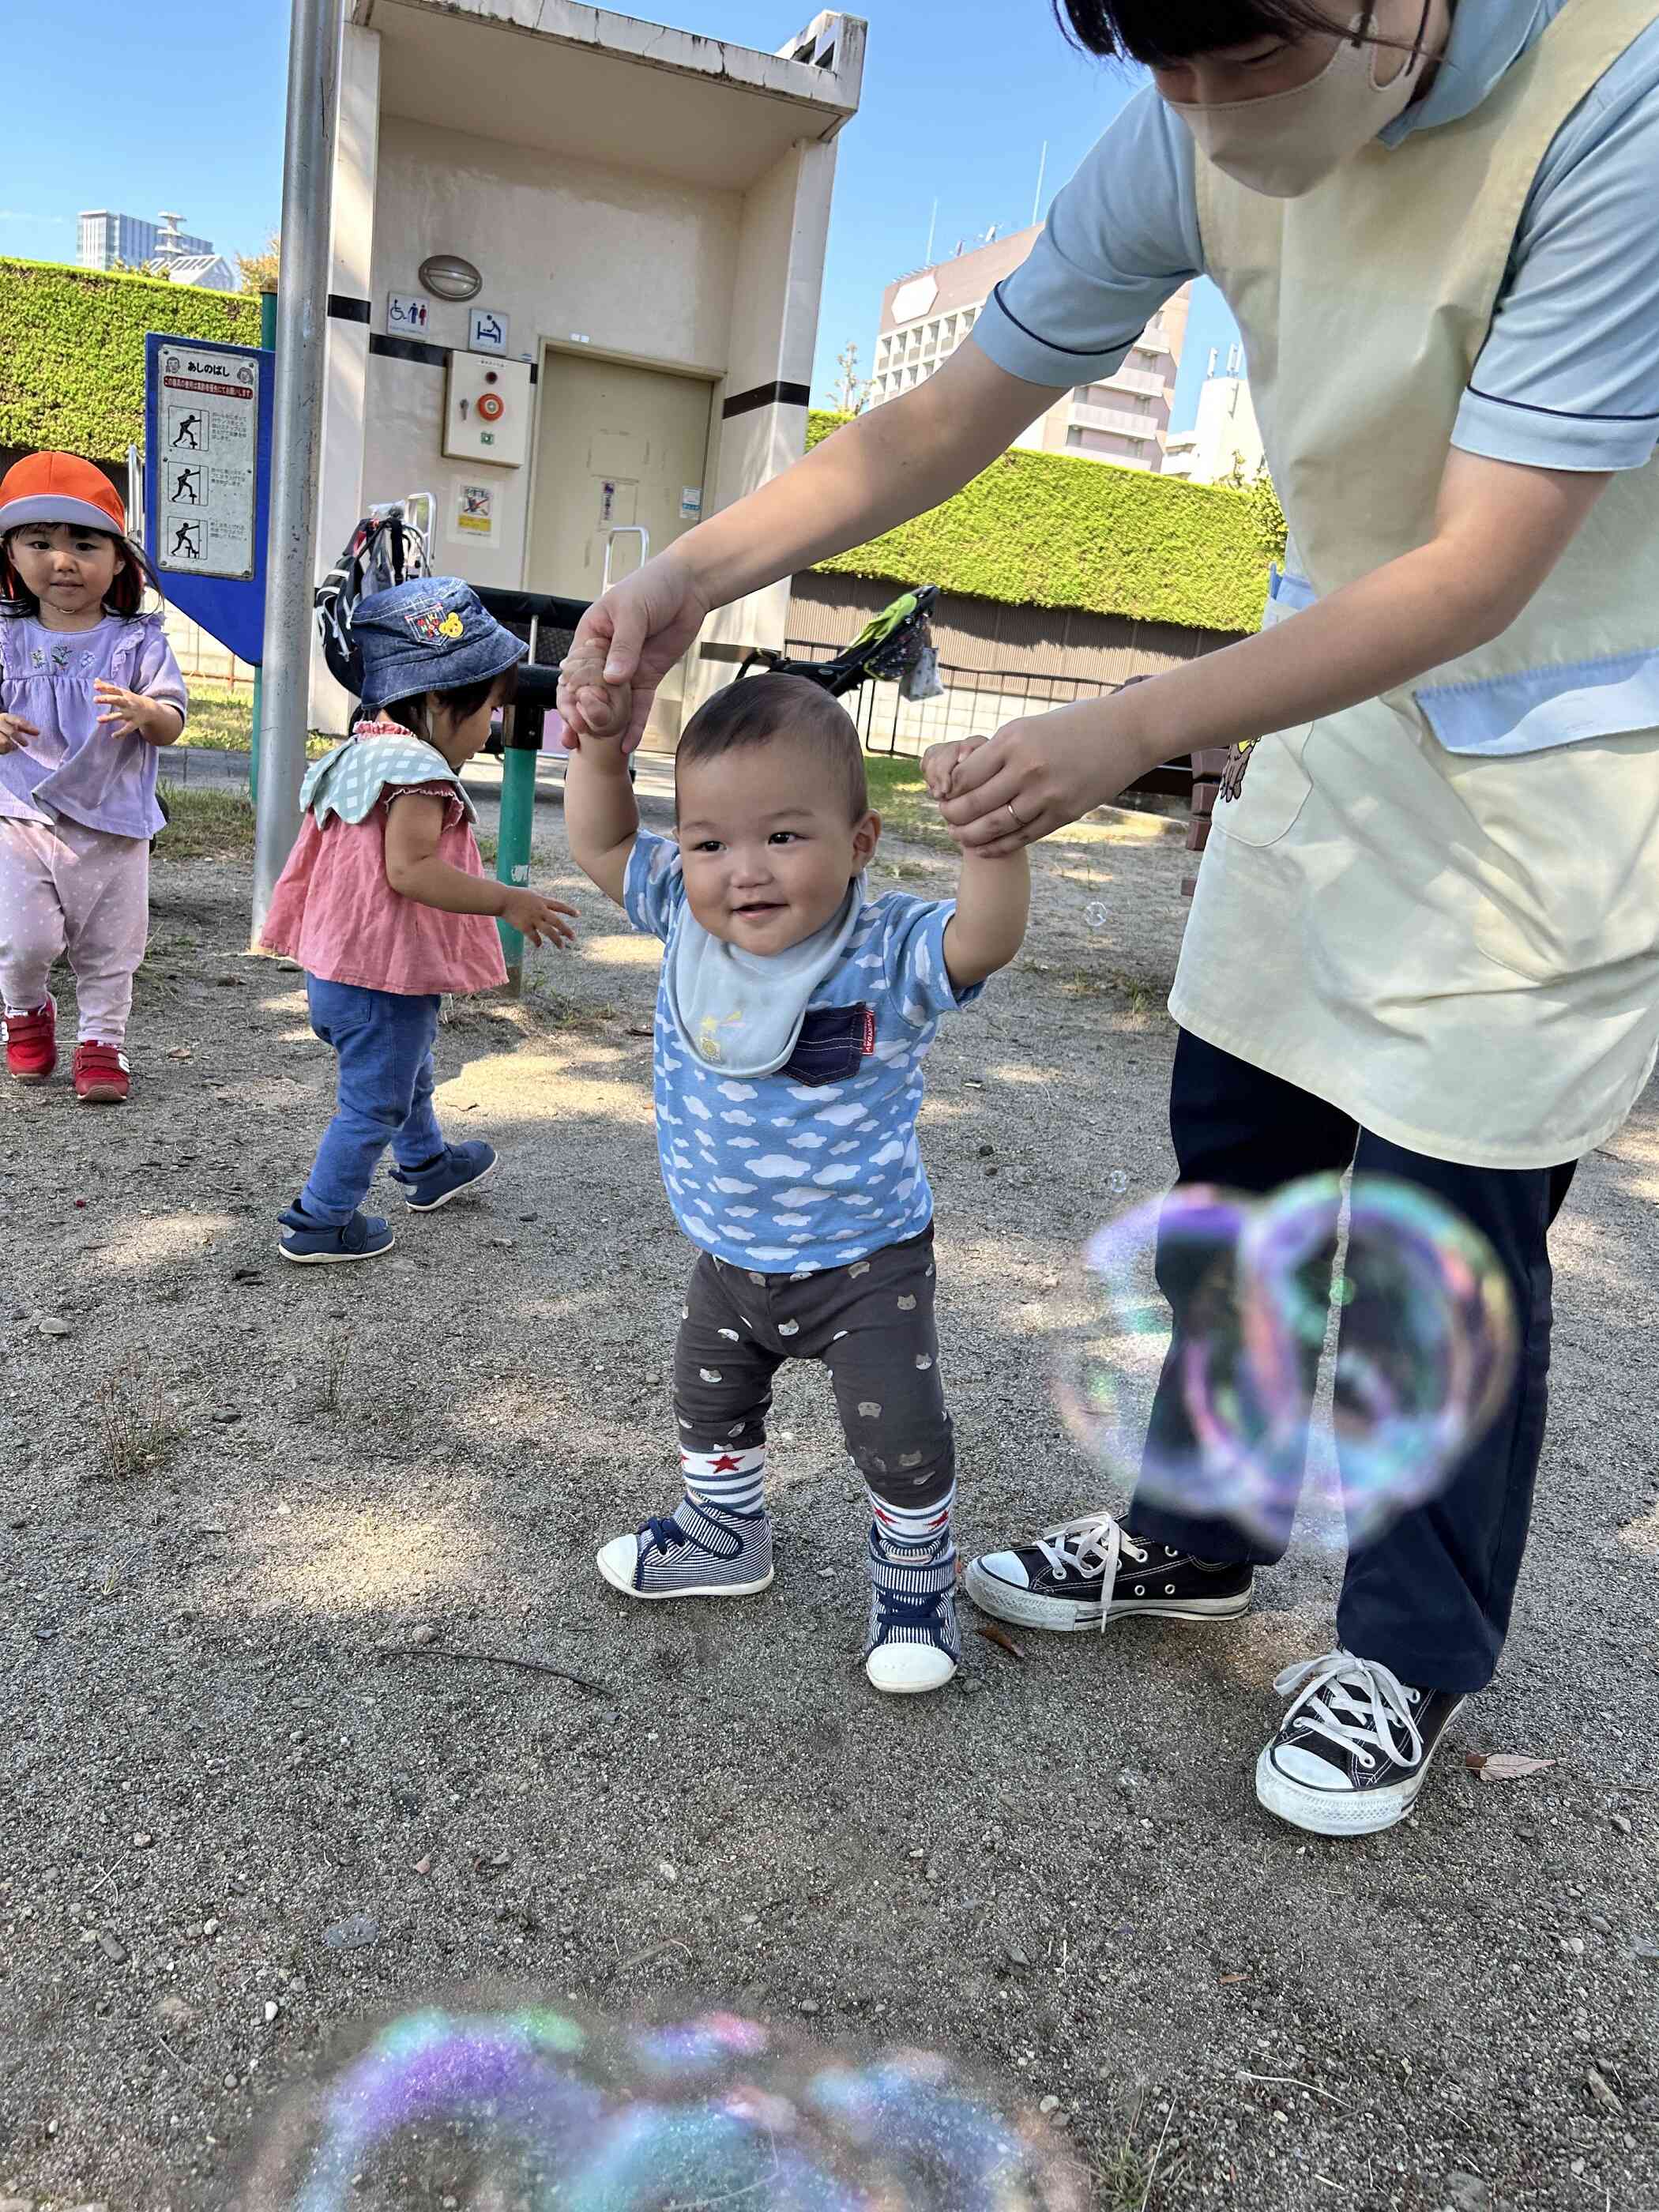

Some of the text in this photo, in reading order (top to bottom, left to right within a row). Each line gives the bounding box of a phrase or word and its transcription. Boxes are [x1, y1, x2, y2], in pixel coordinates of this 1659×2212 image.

[188, 361, 230, 377] あしのばし
